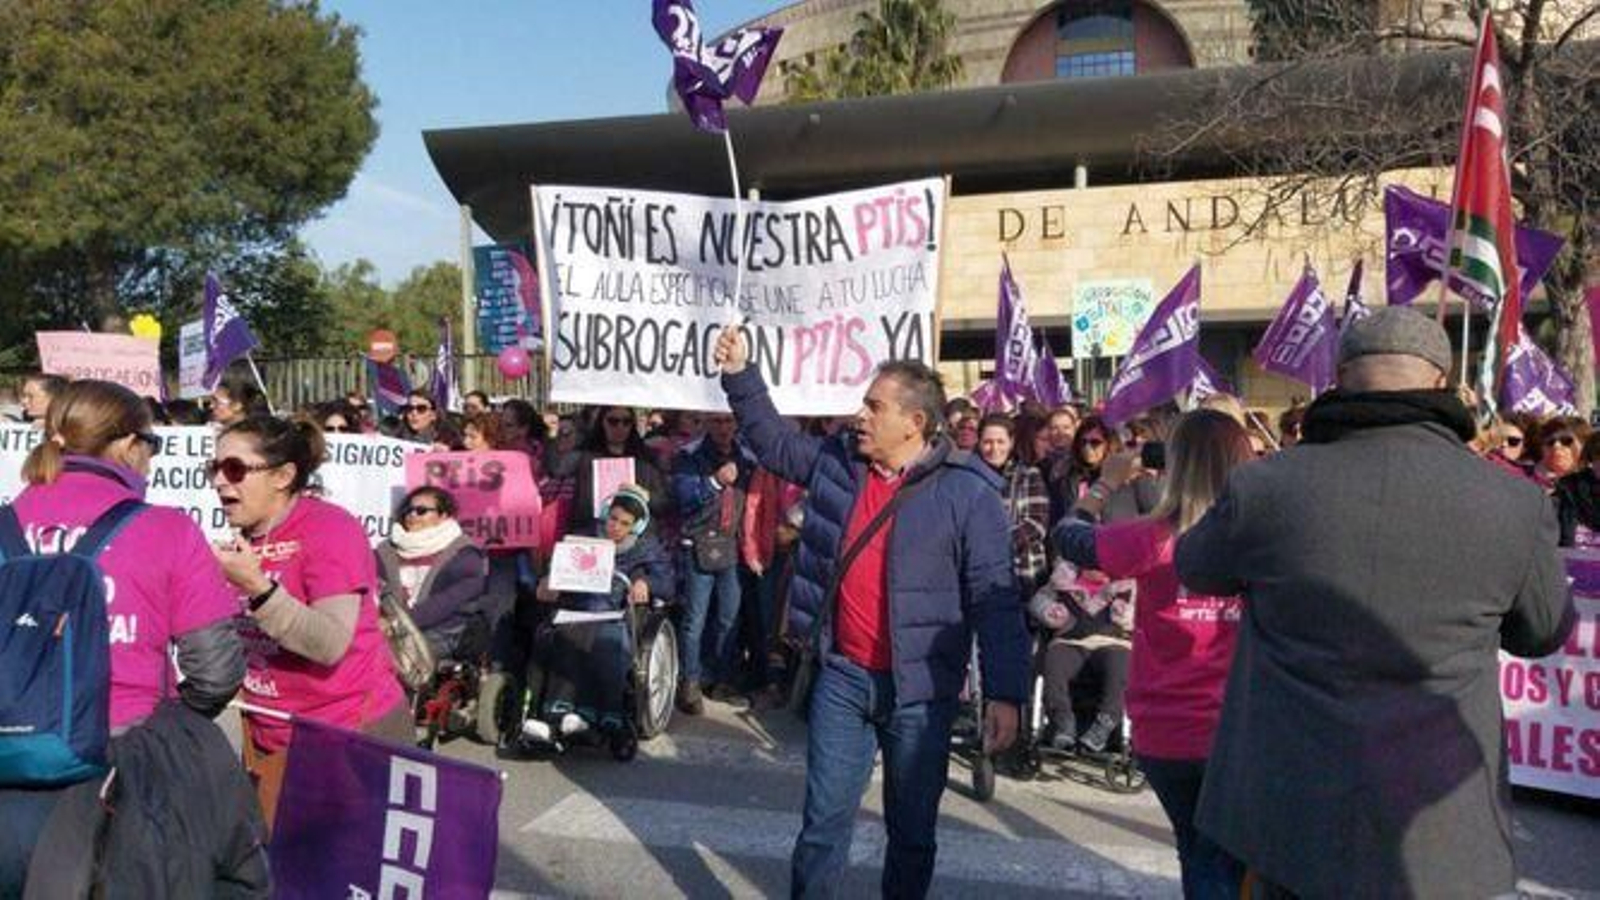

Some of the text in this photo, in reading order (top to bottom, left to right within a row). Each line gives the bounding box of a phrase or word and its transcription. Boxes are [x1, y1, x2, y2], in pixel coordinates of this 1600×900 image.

[645, 203, 678, 266] ES
[700, 205, 853, 272] NUESTRA
[999, 206, 1065, 242] DE
[591, 270, 644, 304] AULA
[763, 284, 804, 316] UNE
[816, 281, 835, 311] A
[839, 273, 867, 305] TU
[873, 260, 930, 301] LUCHA
[880, 311, 937, 371] YA!
[186, 435, 214, 457] LE
[1556, 668, 1575, 707] Y
[1504, 719, 1600, 778] ALES
